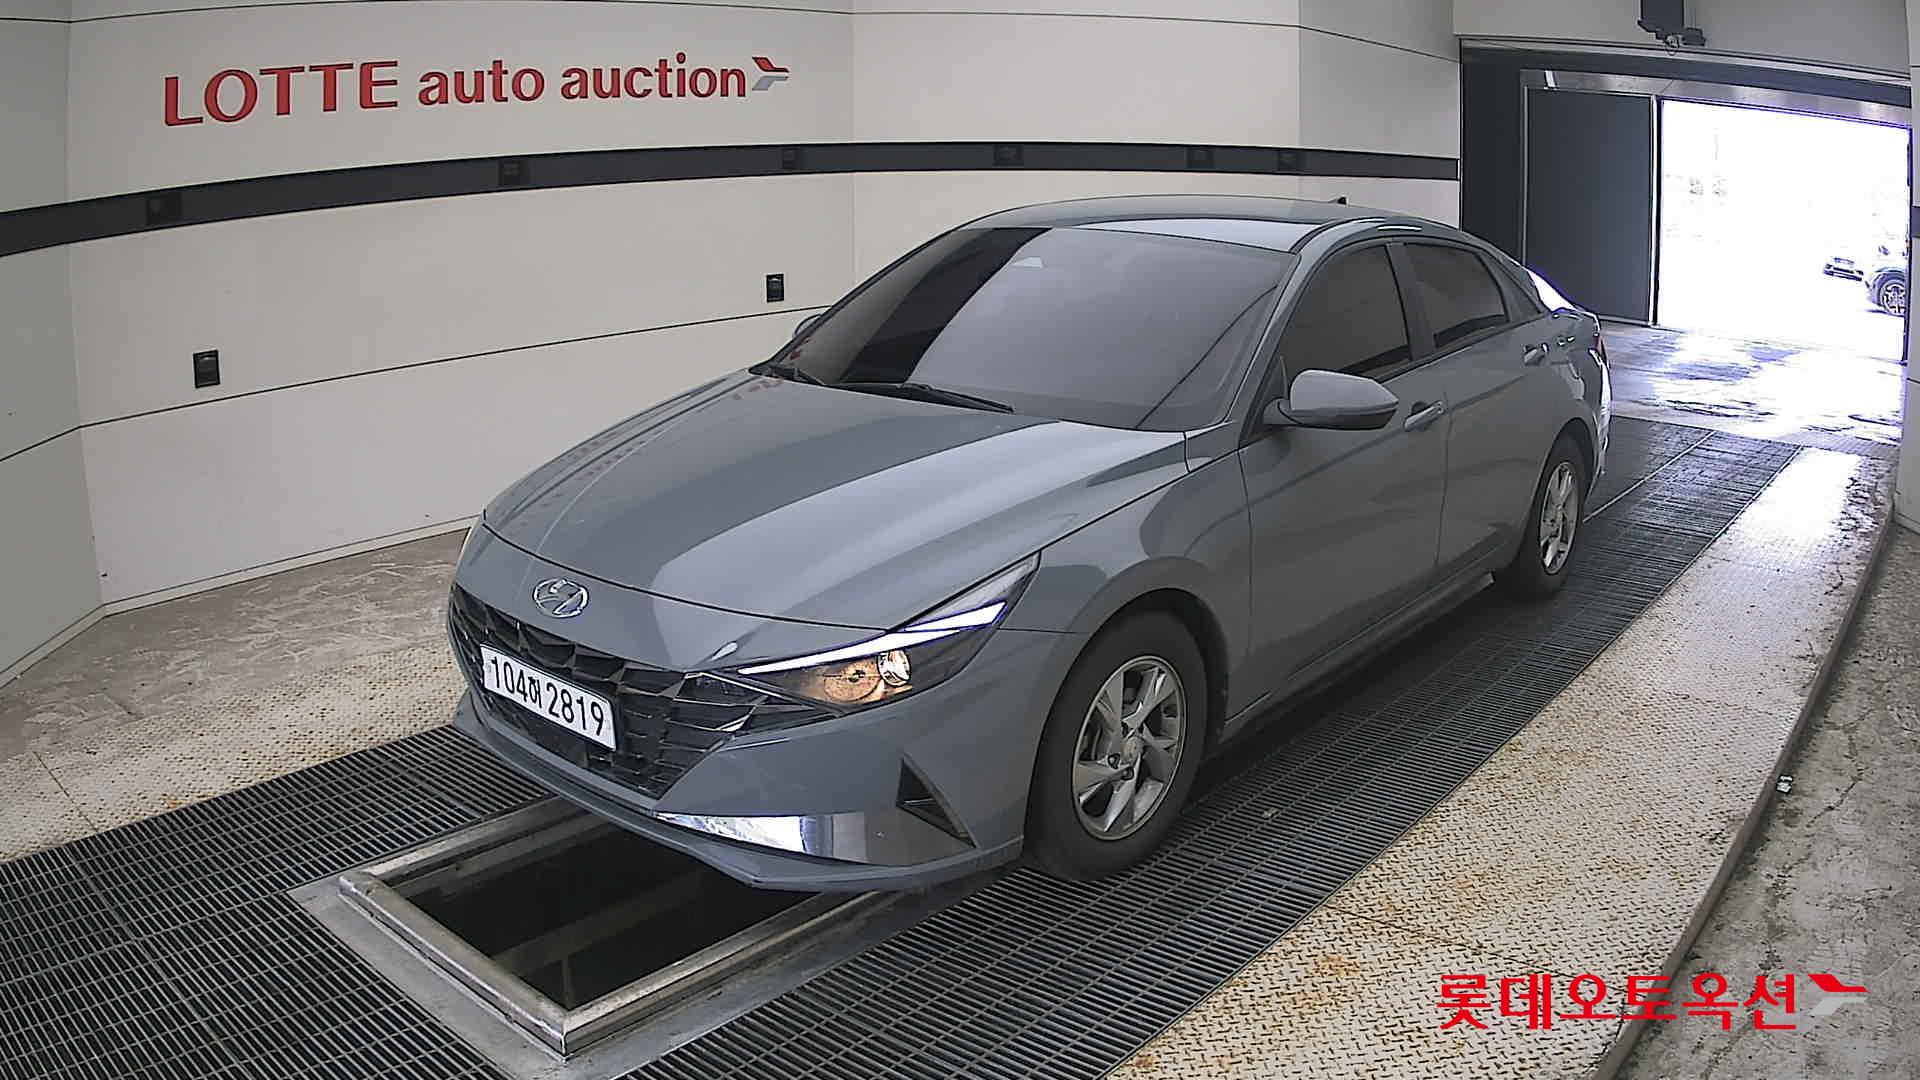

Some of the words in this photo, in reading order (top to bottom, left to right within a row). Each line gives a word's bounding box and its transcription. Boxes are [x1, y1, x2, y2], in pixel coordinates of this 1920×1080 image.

[164, 60, 399, 127] LOTTE
[418, 59, 546, 106] auto
[560, 52, 748, 100] auction
[546, 682, 604, 737] 2819
